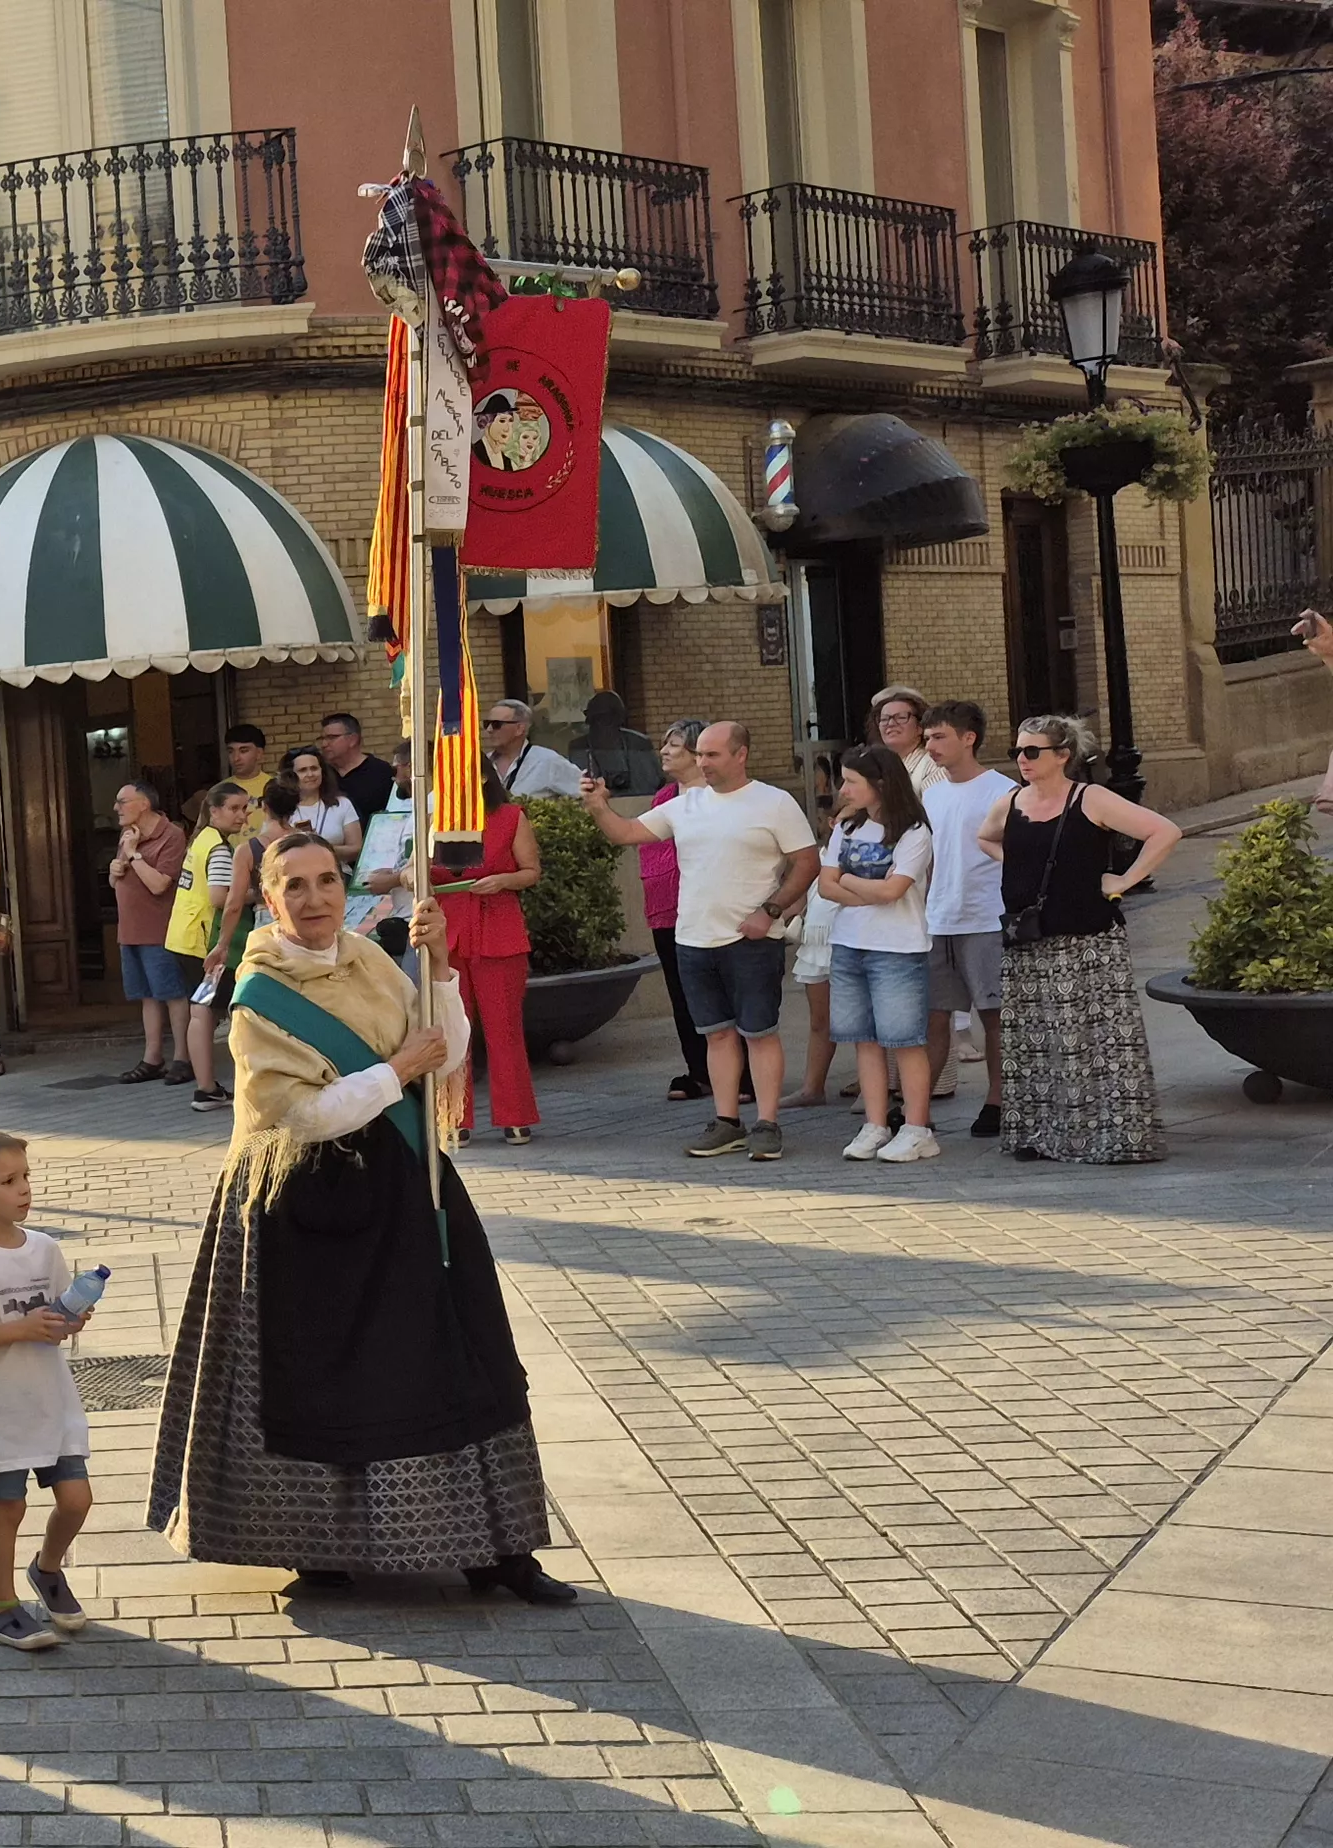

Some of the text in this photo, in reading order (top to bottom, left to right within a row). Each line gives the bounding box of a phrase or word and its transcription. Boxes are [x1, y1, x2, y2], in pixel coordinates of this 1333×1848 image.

[437, 333, 467, 396] FOLKLORE
[431, 429, 453, 440] DEL
[430, 443, 462, 489] CABEZO
[479, 484, 534, 500] HUESCA
